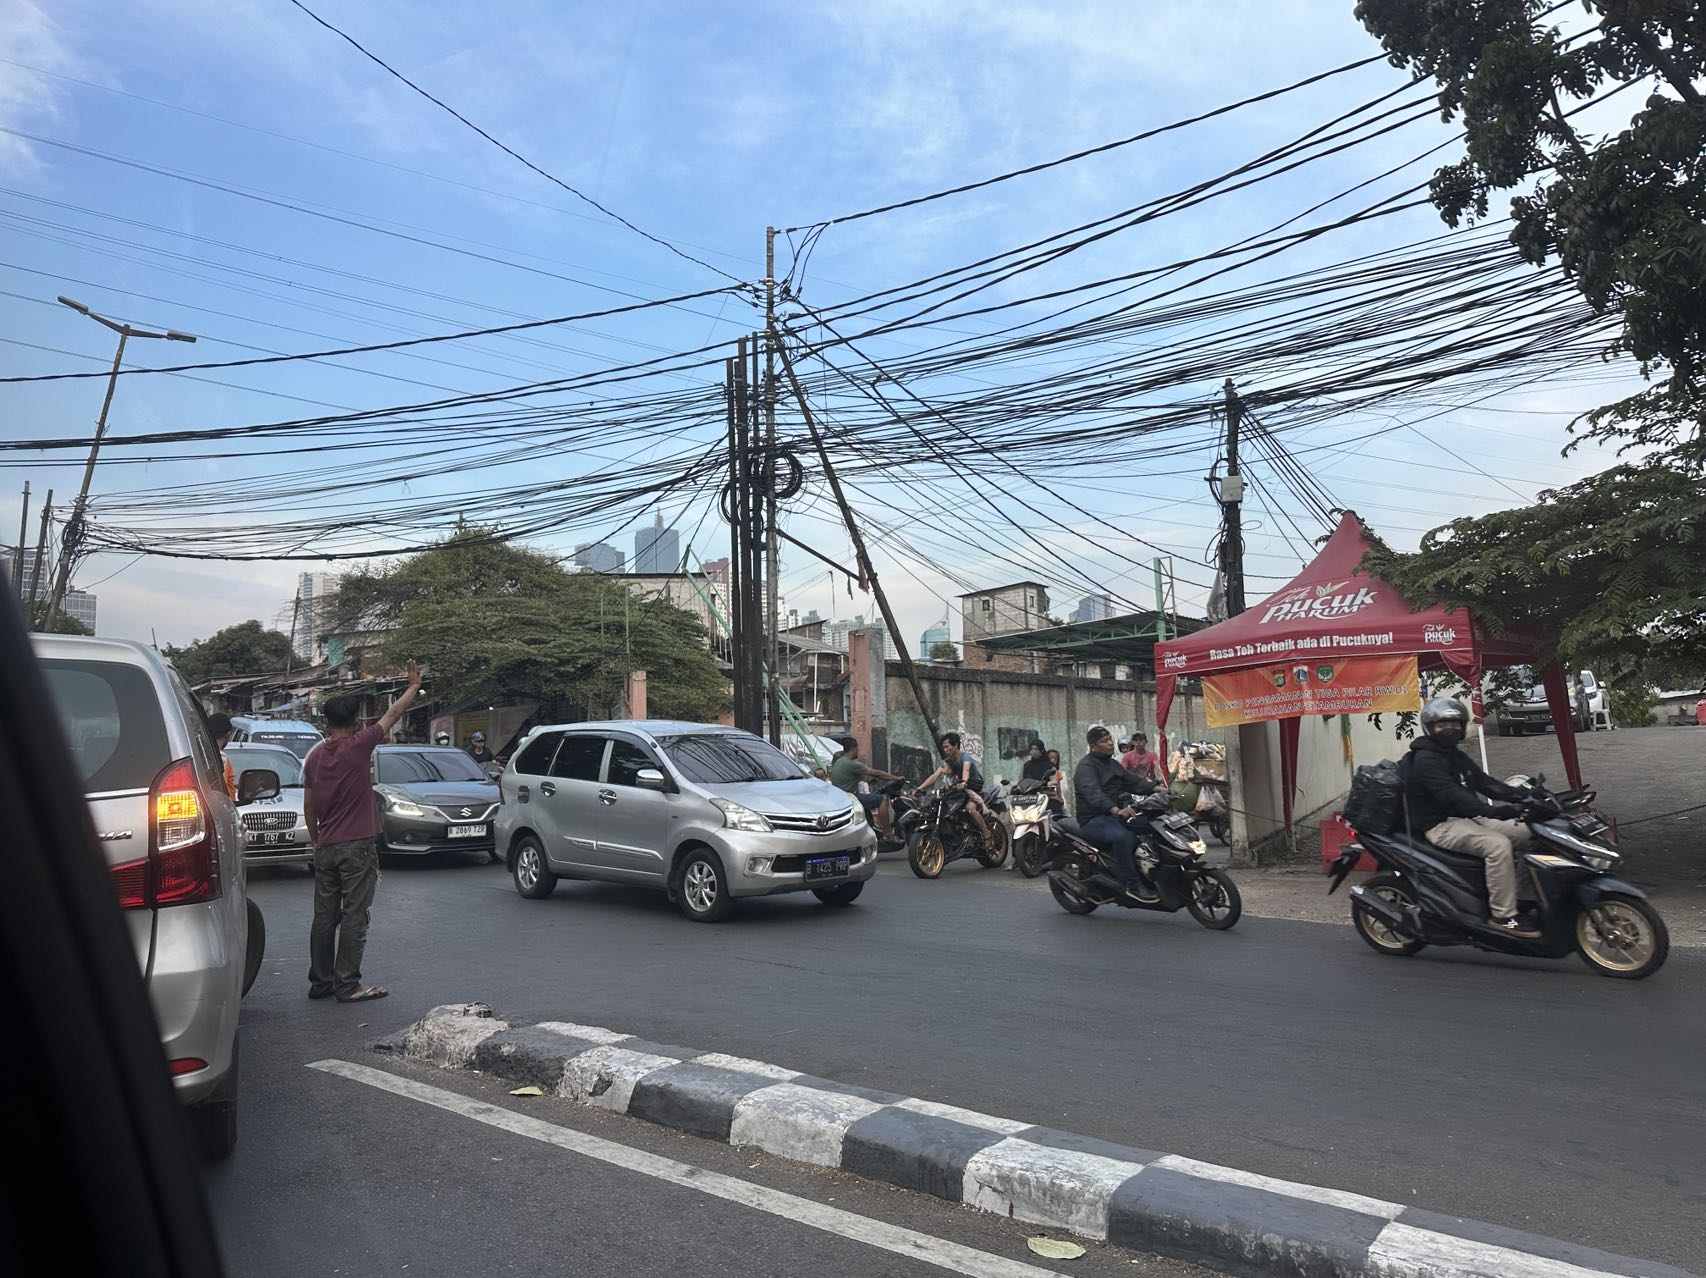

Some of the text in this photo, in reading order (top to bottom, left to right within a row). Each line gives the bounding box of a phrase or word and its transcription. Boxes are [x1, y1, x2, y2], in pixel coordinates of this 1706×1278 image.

[1210, 632, 1393, 660] Rasa Teh Terbaik ada di Pucuknya!
[1214, 699, 1244, 712] POSKO
[1315, 687, 1340, 699] TIGA
[1342, 686, 1374, 698] PILAR
[1243, 702, 1303, 720] KELURAHAN
[264, 832, 279, 841] 1767
